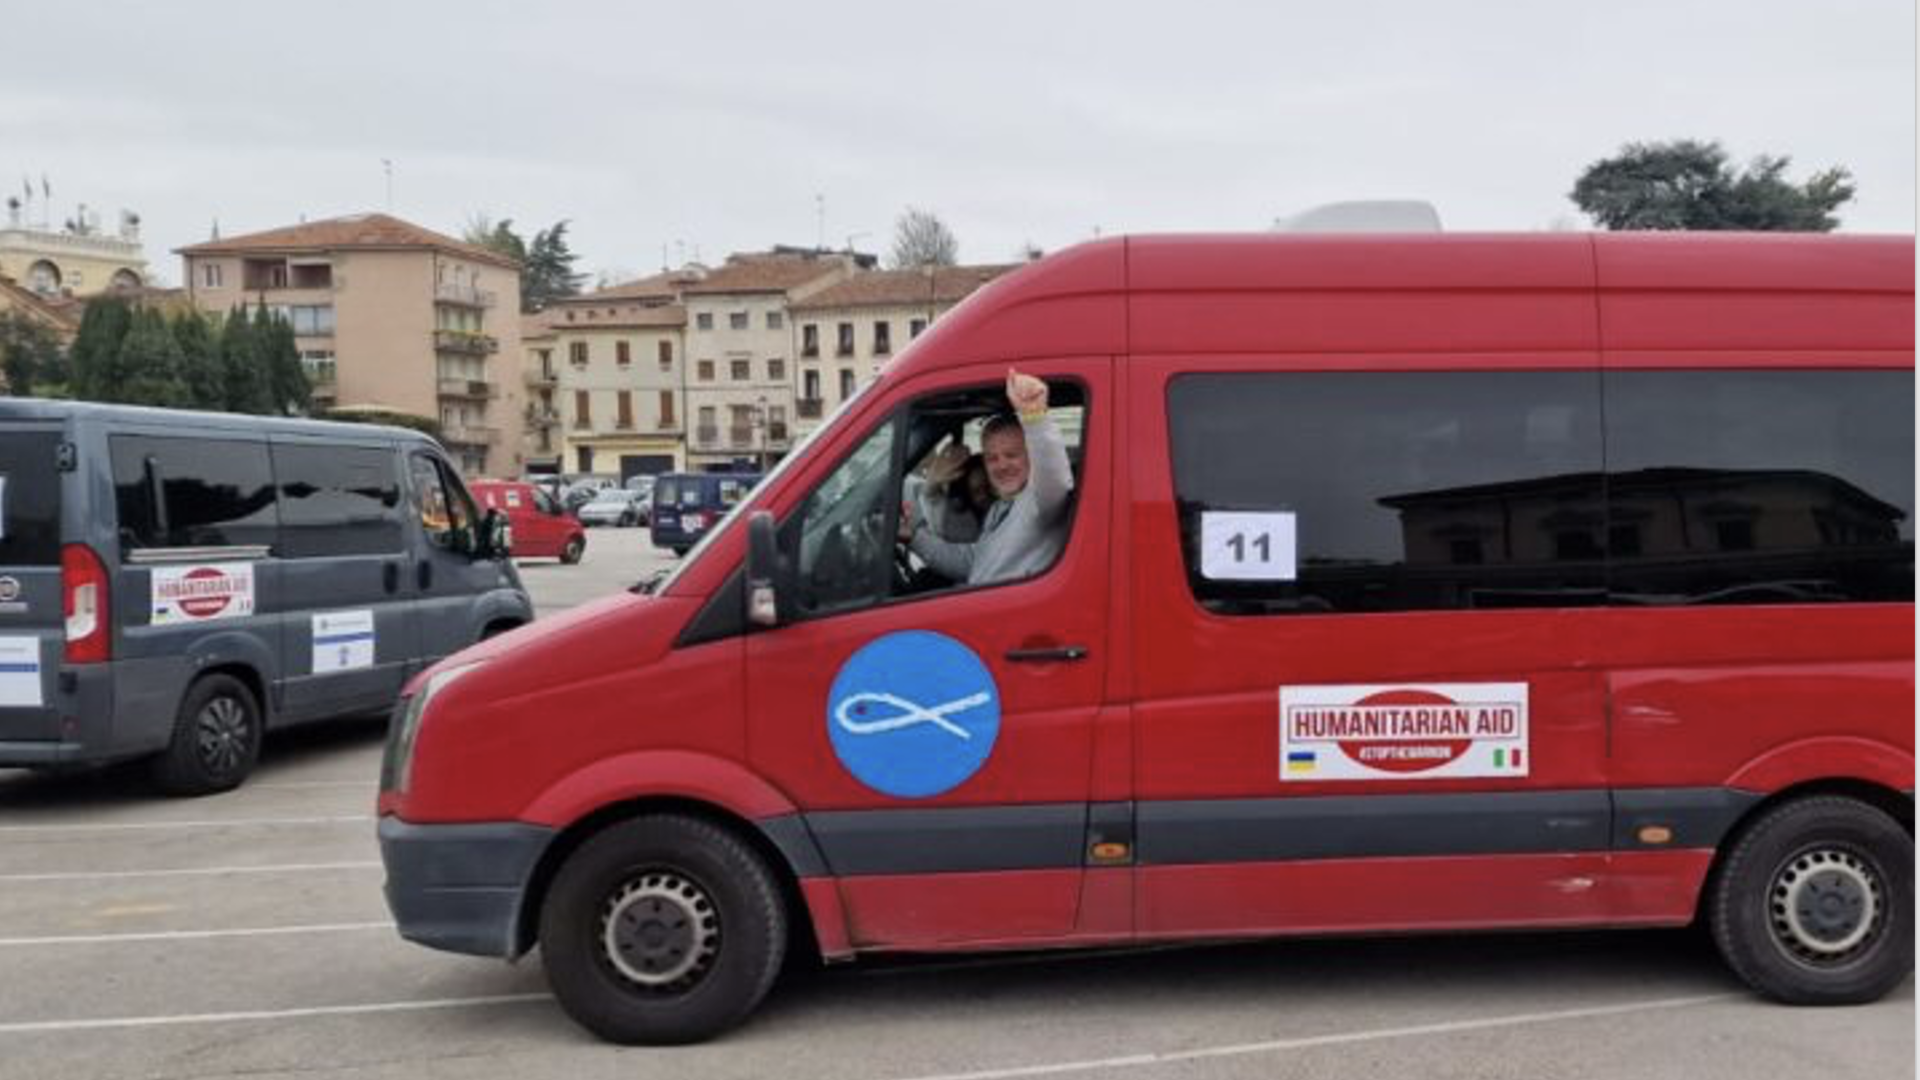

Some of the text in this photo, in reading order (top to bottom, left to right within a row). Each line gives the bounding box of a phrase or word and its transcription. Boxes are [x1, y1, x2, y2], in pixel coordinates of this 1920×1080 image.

[1226, 532, 1270, 563] 11
[1295, 708, 1514, 738] HUMANITARIAN AID
